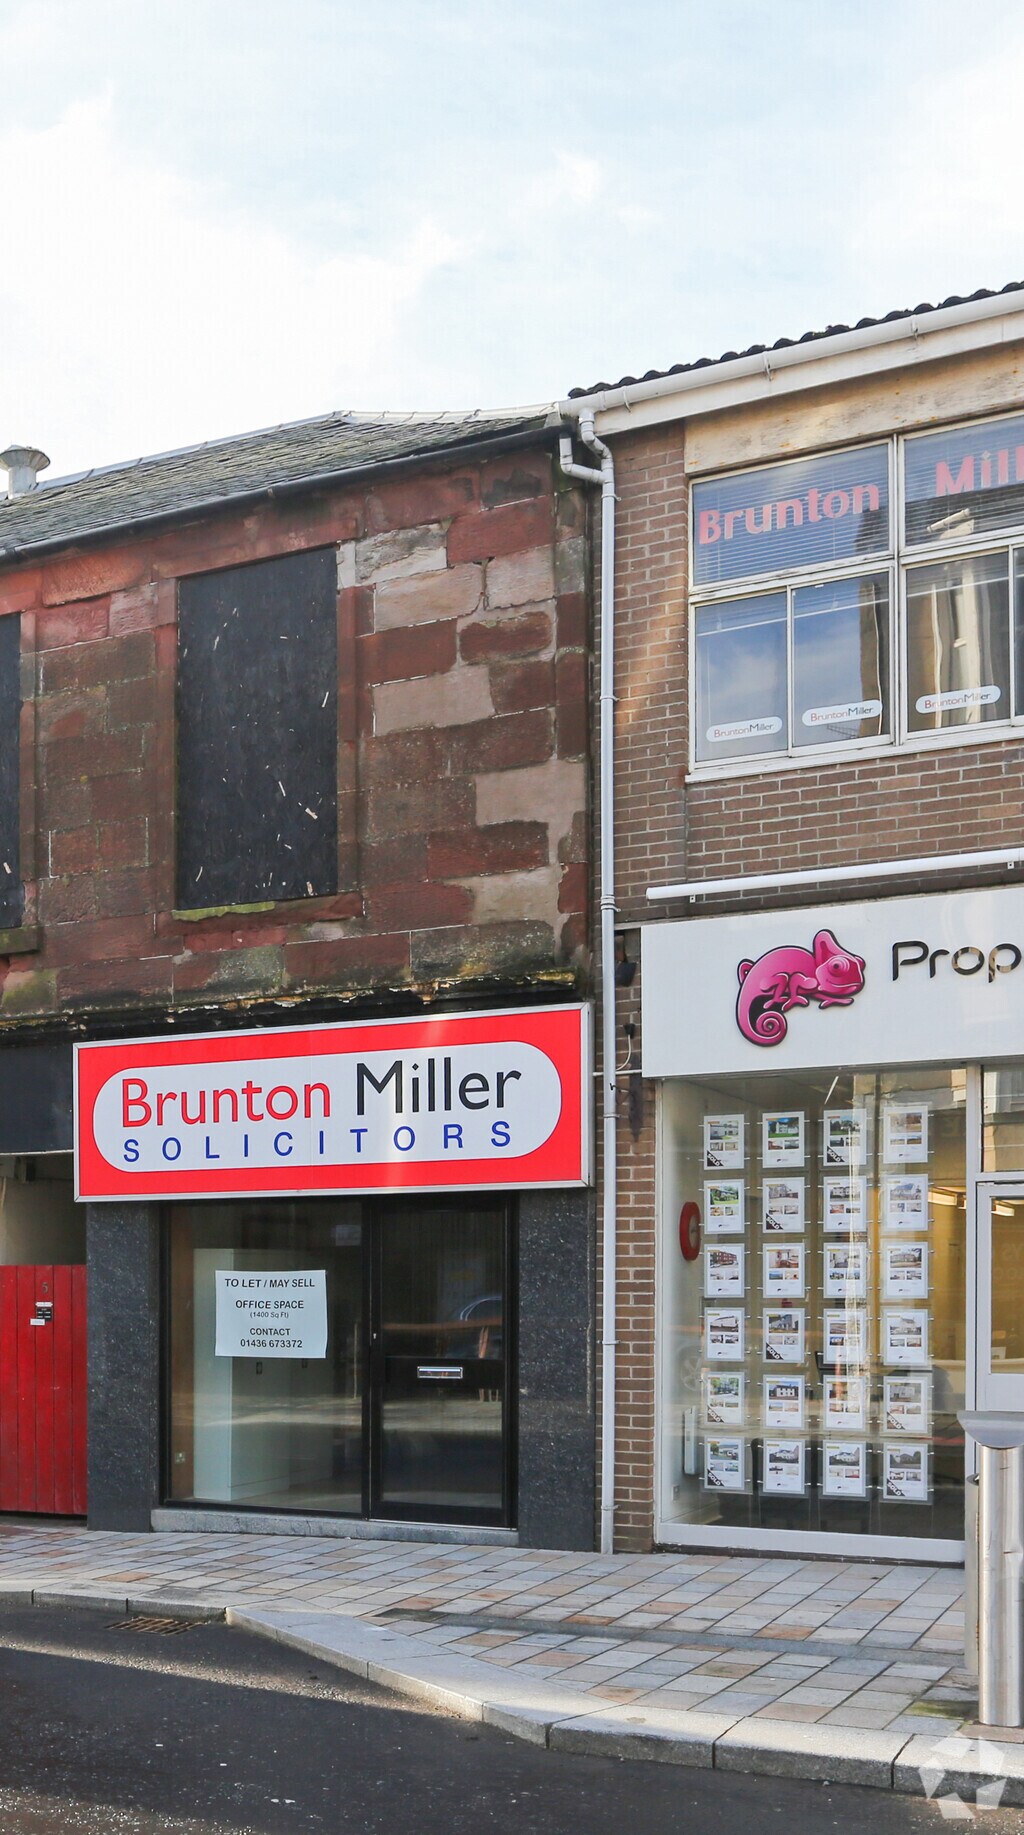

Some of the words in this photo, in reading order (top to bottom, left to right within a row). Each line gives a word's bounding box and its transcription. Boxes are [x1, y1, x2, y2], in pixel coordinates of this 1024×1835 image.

[698, 484, 881, 545] Brunton
[892, 940, 1022, 983] Prop
[122, 1078, 331, 1127] Brunton
[356, 1056, 522, 1115] Miller
[123, 1120, 511, 1163] SOLICITORS
[707, 1153, 721, 1166] SOLD
[827, 1148, 841, 1162] SOLD
[766, 1216, 780, 1230] SOLD
[225, 1278, 239, 1288] TO
[241, 1279, 262, 1288] LET
[269, 1279, 290, 1288] MAY
[291, 1278, 315, 1288] SELL
[235, 1299, 272, 1309] OFFICE
[273, 1300, 304, 1309] SPACE
[249, 1311, 269, 1319] (1400
[249, 1327, 291, 1336] CONTACT
[240, 1339, 267, 1348] 01436
[268, 1339, 303, 1348] 673372
[766, 1345, 780, 1360] SOLD
[707, 1409, 721, 1423] SOLD
[887, 1415, 902, 1430] SOLD
[707, 1472, 721, 1486] SOLD
[887, 1482, 902, 1496] SOLD
